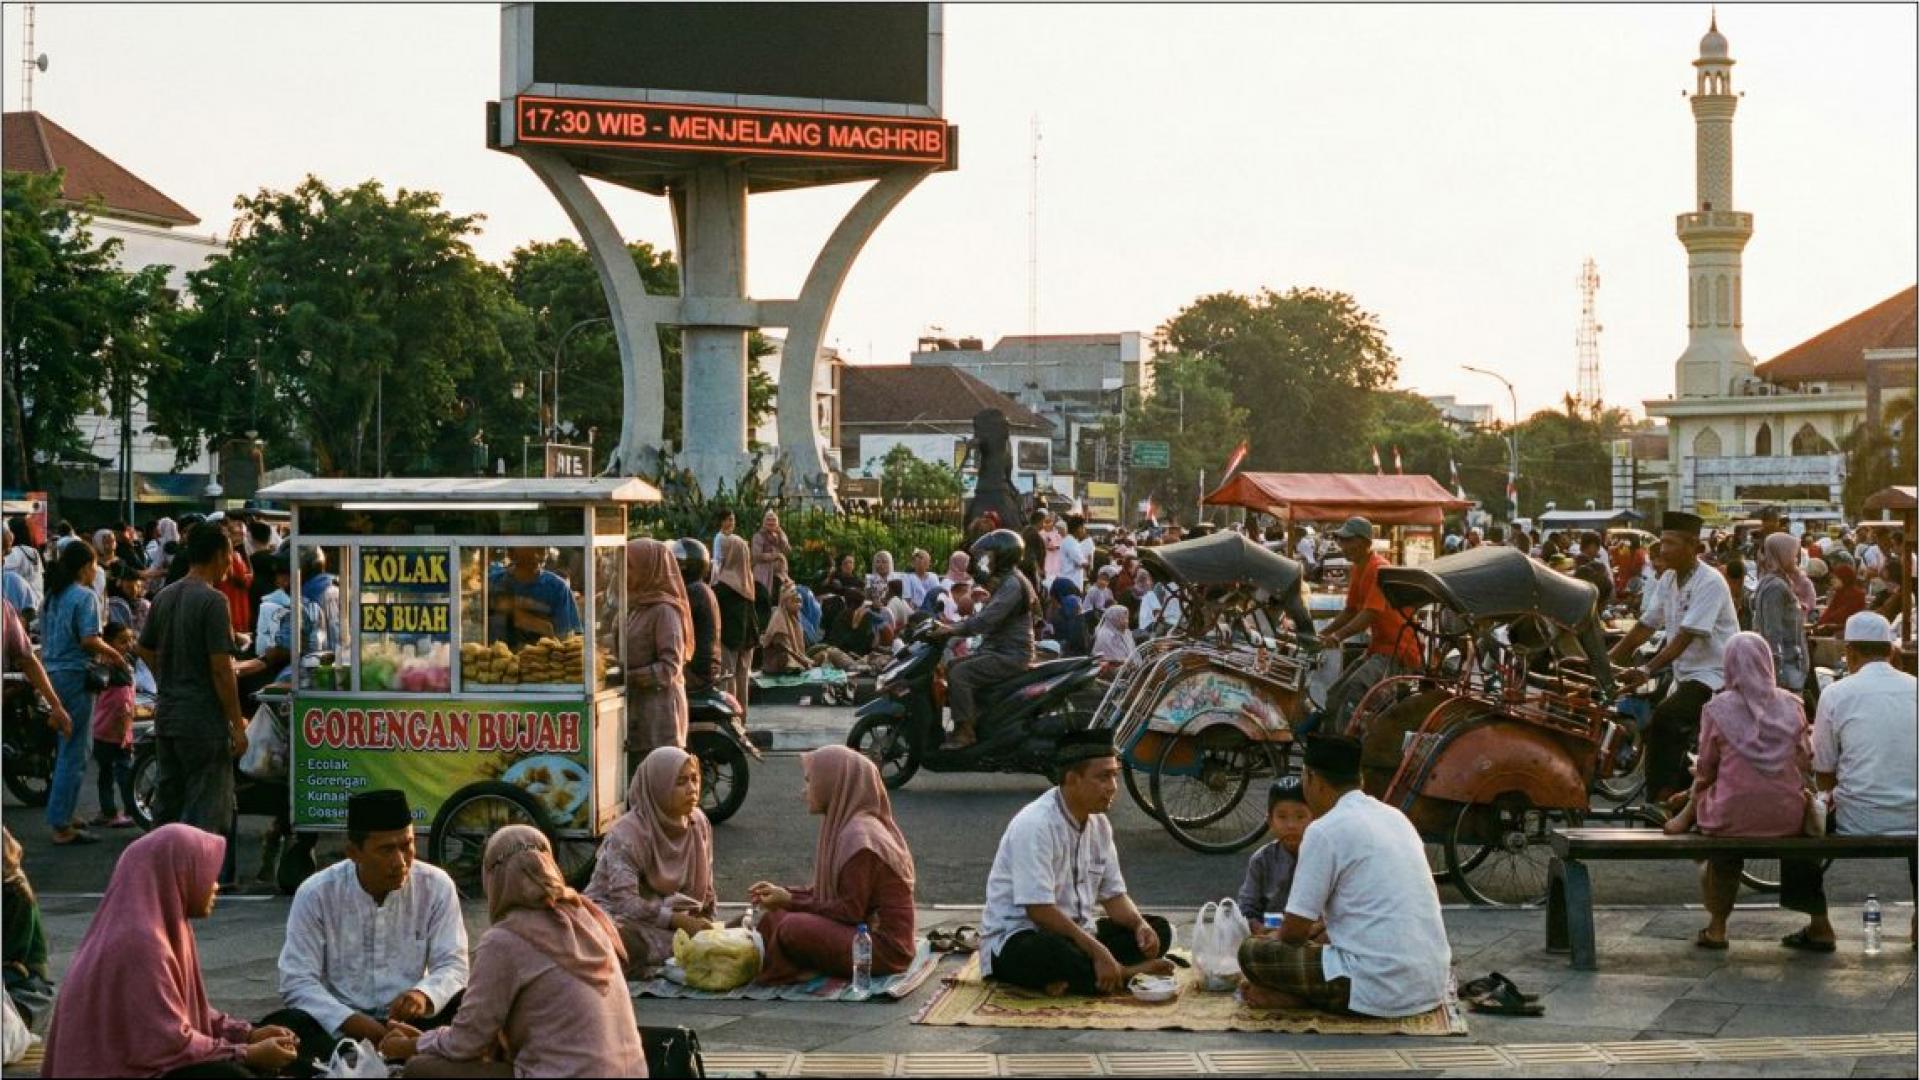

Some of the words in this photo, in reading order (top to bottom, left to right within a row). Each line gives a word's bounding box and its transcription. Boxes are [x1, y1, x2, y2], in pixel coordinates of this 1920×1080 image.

[525, 109, 591, 134] 17:30
[597, 112, 647, 136] WIB
[669, 115, 822, 146] MENJELANG
[829, 126, 941, 152] MAGHRIB
[364, 555, 448, 584] KOLAK
[362, 604, 386, 632] ES
[392, 604, 449, 632] BUAH
[304, 709, 471, 750] GORENGAN
[476, 711, 582, 752] BUJAH
[307, 775, 367, 788] Gorengan
